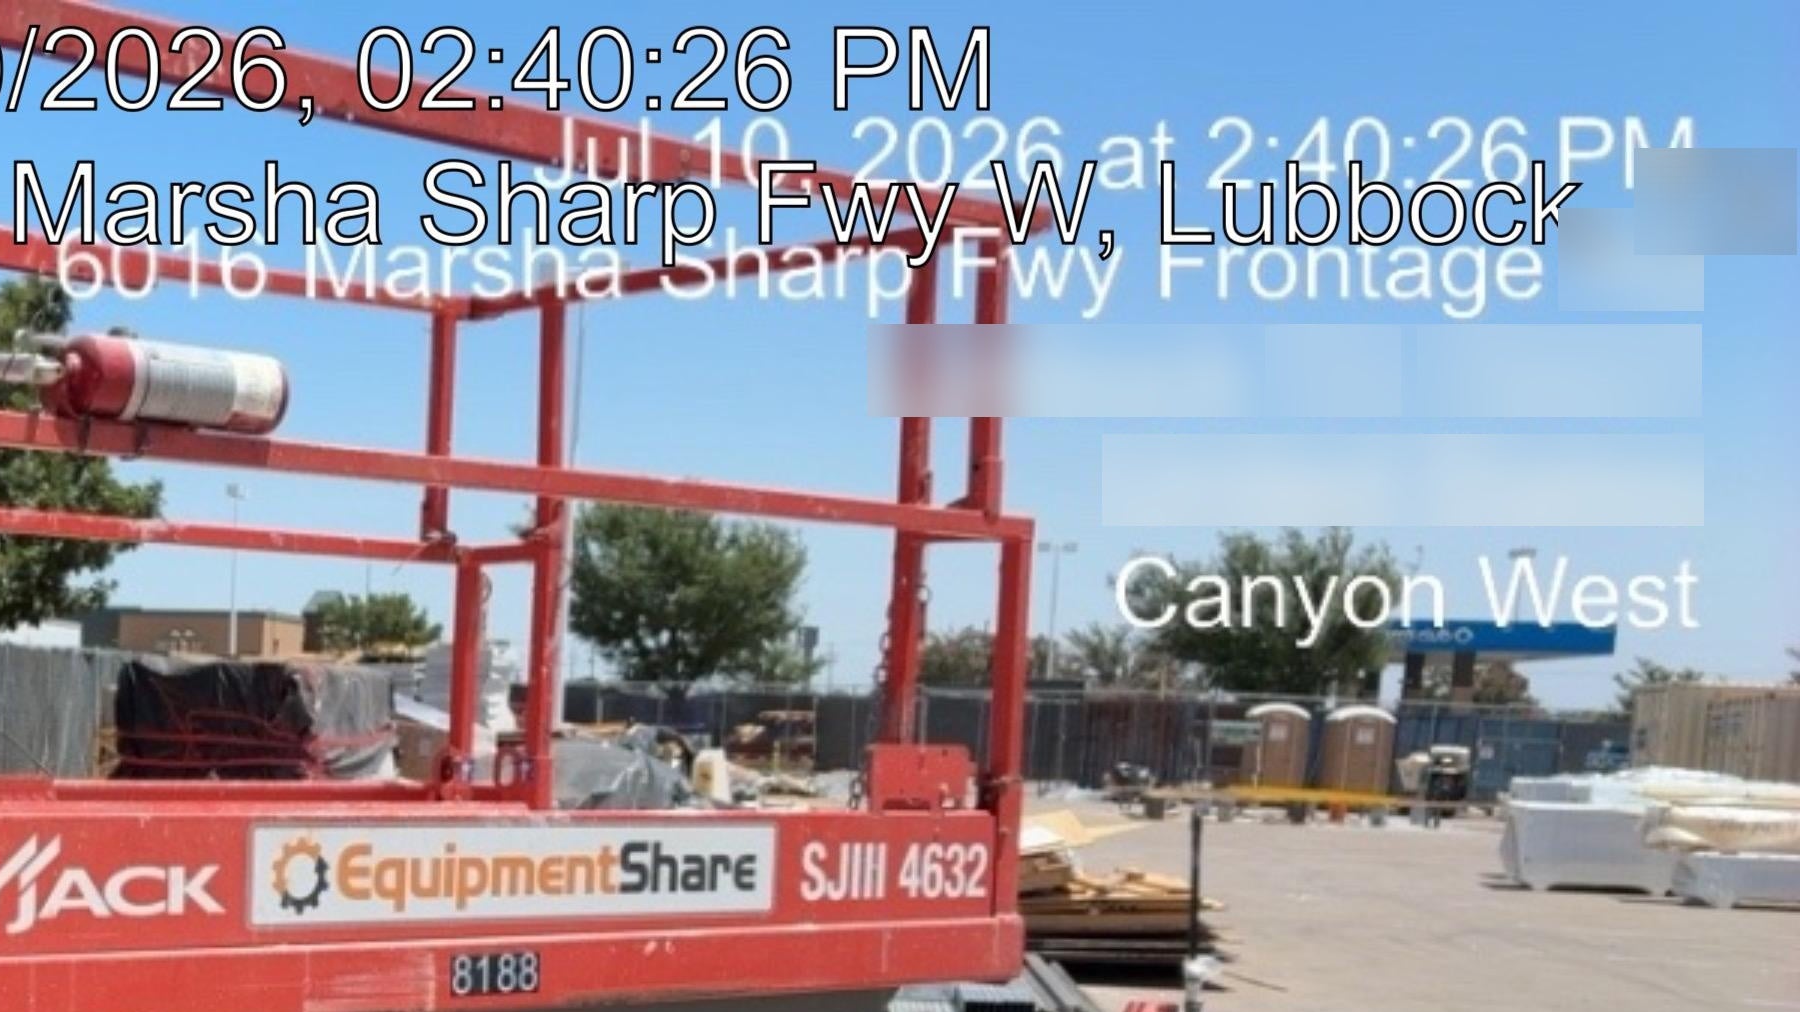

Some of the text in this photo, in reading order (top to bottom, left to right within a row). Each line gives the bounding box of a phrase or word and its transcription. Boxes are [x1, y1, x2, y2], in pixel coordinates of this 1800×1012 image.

[336, 841, 758, 912] EquipmentShare
[800, 840, 989, 900] SJIII 4632
[452, 951, 539, 995] 8188
